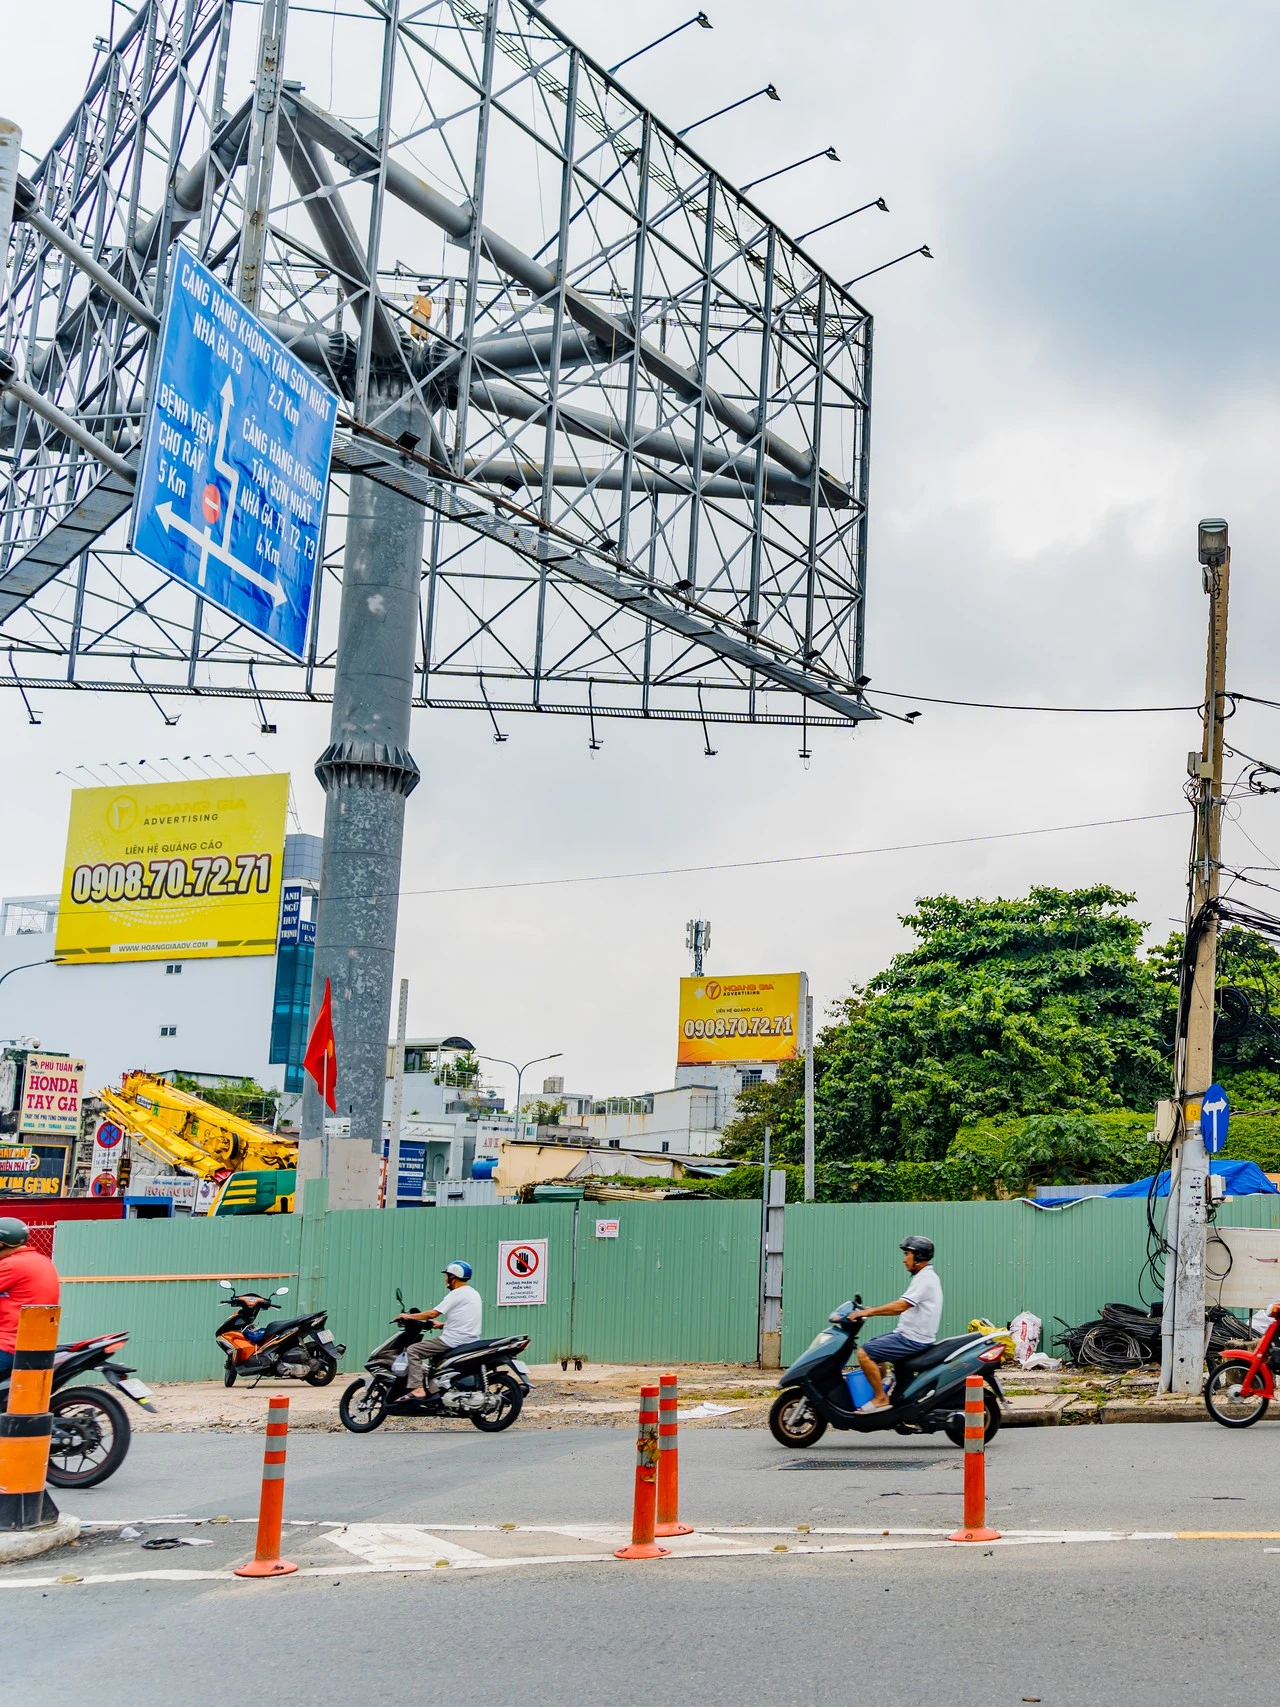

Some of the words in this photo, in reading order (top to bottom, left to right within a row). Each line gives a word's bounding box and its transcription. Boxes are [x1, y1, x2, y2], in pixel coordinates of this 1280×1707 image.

[180, 262, 211, 307] CẢNG
[210, 289, 238, 333] HÀNG
[238, 317, 272, 365] KHÔNG
[271, 348, 290, 383] TÂN
[289, 368, 309, 401] SƠN
[308, 384, 332, 422] NHẤT
[192, 312, 215, 351] NHÀ
[217, 333, 229, 364] GA
[231, 346, 243, 375] T3
[160, 383, 189, 426] BỆNH
[190, 407, 214, 446] VIỆN
[284, 396, 300, 427] Km
[158, 421, 183, 461] CHỢ
[182, 438, 205, 474] RẪY
[242, 415, 268, 454] CẢNG
[268, 437, 294, 476] HÀNG
[293, 461, 323, 501] KHÔNG
[158, 459, 167, 483] 5
[167, 465, 187, 498] Km
[251, 458, 270, 490] TÂN
[270, 475, 290, 507] SƠN
[289, 494, 313, 525] NHẤT
[240, 486, 260, 520] NHÀ
[261, 502, 274, 531] GA
[303, 535, 316, 560] T3
[255, 533, 263, 556] 4
[264, 538, 280, 567] Km
[143, 800, 211, 815] HOANG
[215, 798, 247, 811] GIA
[143, 813, 219, 826] ADVERTISING
[125, 845, 144, 855] LIÊN
[147, 844, 158, 855] HỆ
[161, 840, 197, 852] QUẢNG
[200, 840, 223, 851] CÁO
[71, 853, 272, 905] 0908.70.72.71
[285, 892, 300, 901] ANH
[283, 916, 298, 925] HUY
[301, 923, 316, 932] HUY
[118, 941, 209, 952] WWW.HOANGGIAADV.COM
[281, 930, 298, 939] TRỊNH
[684, 1015, 794, 1039] 0908.70.72.71
[29, 1075, 78, 1093] HONDA
[27, 1094, 55, 1110] TAY
[57, 1096, 78, 1112] GA
